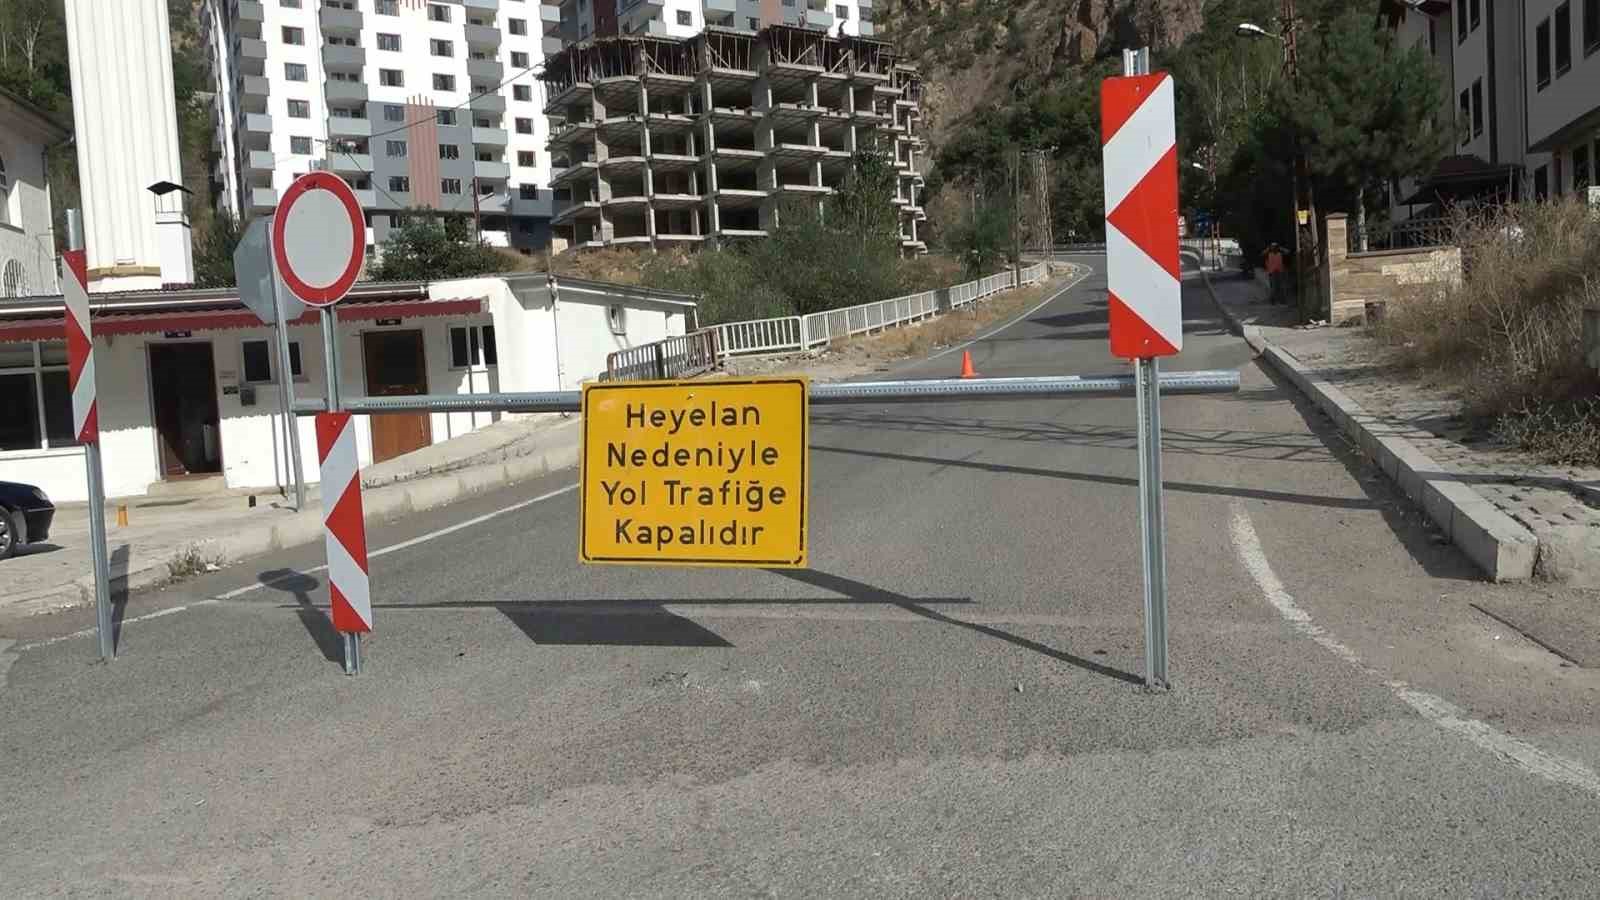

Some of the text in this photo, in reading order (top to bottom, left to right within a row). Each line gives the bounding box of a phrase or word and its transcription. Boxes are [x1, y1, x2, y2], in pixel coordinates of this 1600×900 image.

[626, 401, 760, 434] Heyelan
[607, 440, 779, 473] Nedeniyle
[600, 479, 787, 512] Yol Trafiğe
[615, 519, 764, 551] Kapalıdır
